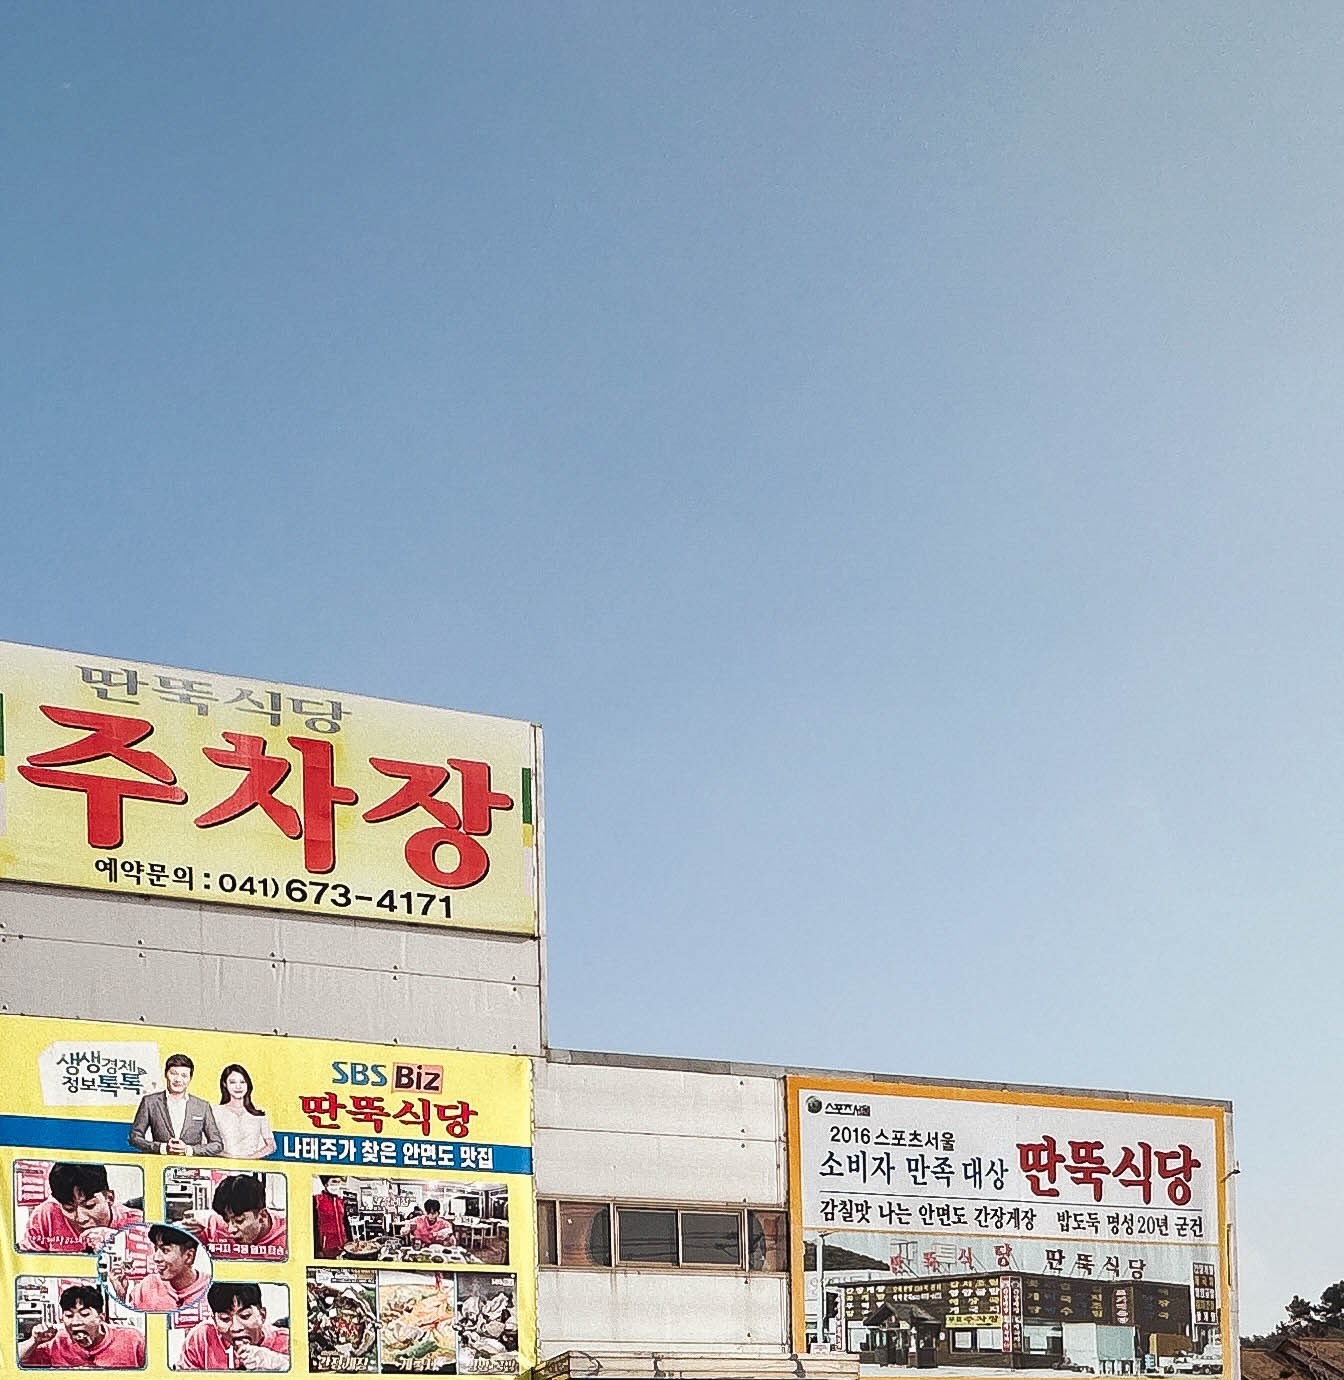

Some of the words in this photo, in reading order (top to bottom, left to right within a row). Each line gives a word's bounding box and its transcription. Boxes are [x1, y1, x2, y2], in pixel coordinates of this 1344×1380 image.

[75, 664, 352, 734] 딴뚝식당
[17, 704, 515, 889] 주차장
[56, 1050, 136, 1076] 생생경제
[331, 1061, 388, 1087] SBS
[394, 1064, 441, 1091] Biz
[61, 1072, 144, 1098] 정보톡톡
[298, 1091, 479, 1139] 딴뚝식당
[282, 1135, 357, 1162] 나태주가
[361, 1140, 397, 1164] 찾은
[402, 1142, 455, 1166] 안면도
[459, 1145, 494, 1170] 맛집
[829, 1125, 871, 1145] 2016
[873, 1128, 956, 1152] 스포츠서울
[818, 1149, 897, 1186] 소비자
[905, 1153, 955, 1189] 만족
[961, 1155, 1009, 1191] 대상
[1015, 1134, 1202, 1206] 딴뚝식당
[819, 1198, 873, 1224] 감칠맛
[878, 1200, 913, 1226] 나는
[918, 1202, 969, 1227] 안면도
[973, 1205, 1038, 1231] 간장게장
[1056, 1209, 1101, 1235] 밥도둑
[1106, 1212, 1135, 1236] 명성
